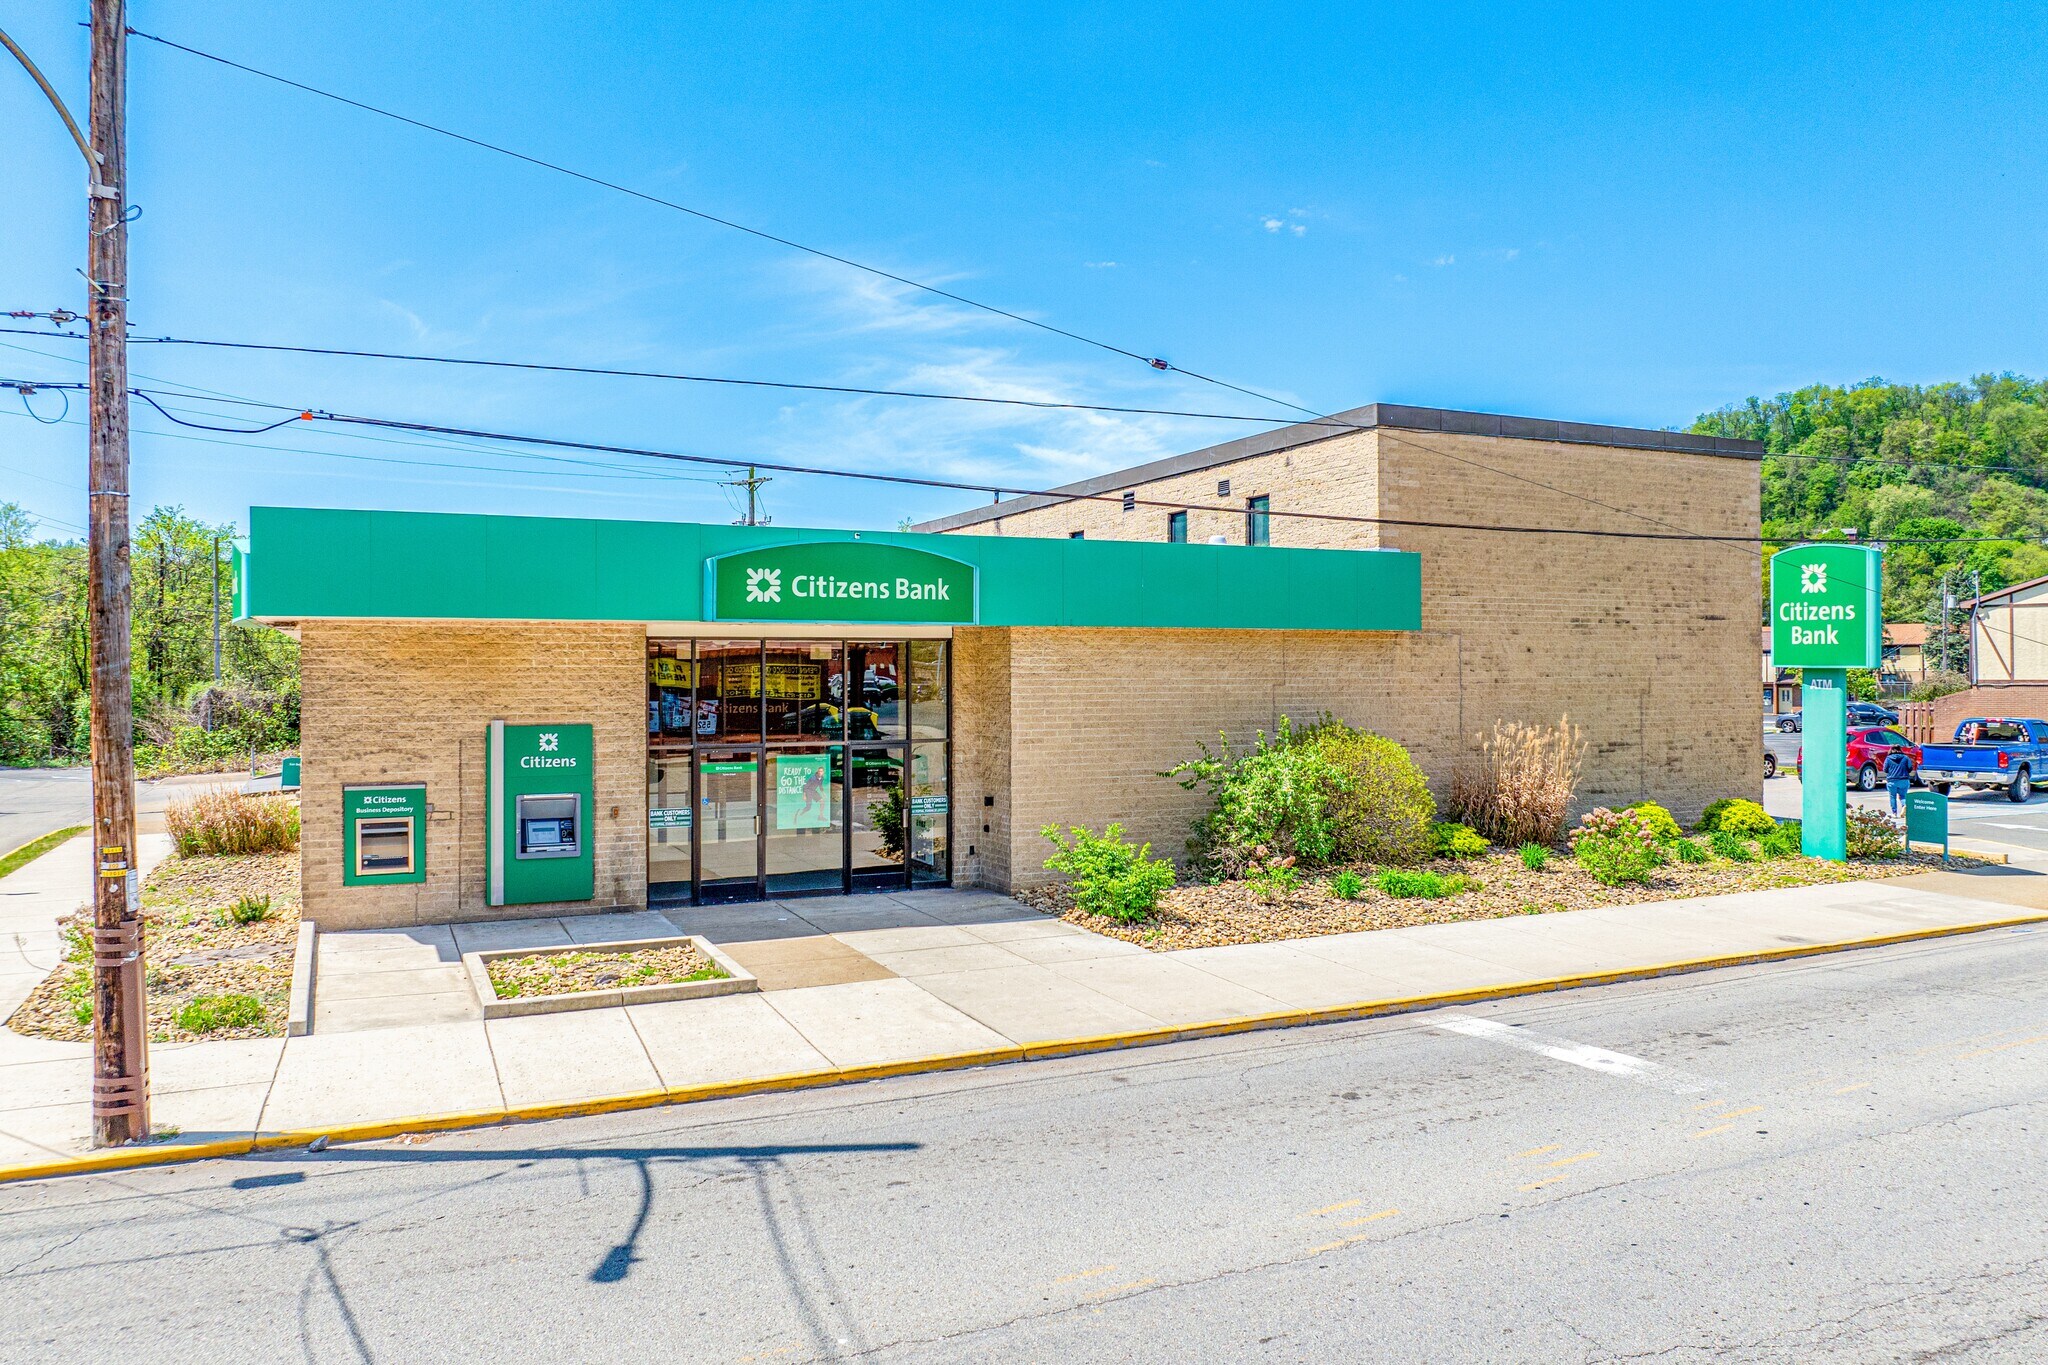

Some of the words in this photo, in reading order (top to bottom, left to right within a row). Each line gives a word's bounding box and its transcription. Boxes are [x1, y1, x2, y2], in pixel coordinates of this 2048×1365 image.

[791, 575, 890, 599] Citizens
[895, 578, 950, 601] Bank
[1779, 601, 1855, 622] Citizens
[1791, 624, 1839, 645] Bank
[1810, 679, 1832, 690] ATM
[520, 756, 577, 769] Citizens
[783, 767, 801, 776] READY
[803, 767, 812, 775] TO
[780, 776, 792, 786] GO
[793, 775, 806, 786] THE
[778, 786, 803, 794] DISTANCE
[373, 796, 406, 804] Citizens
[382, 806, 414, 814] Depository
